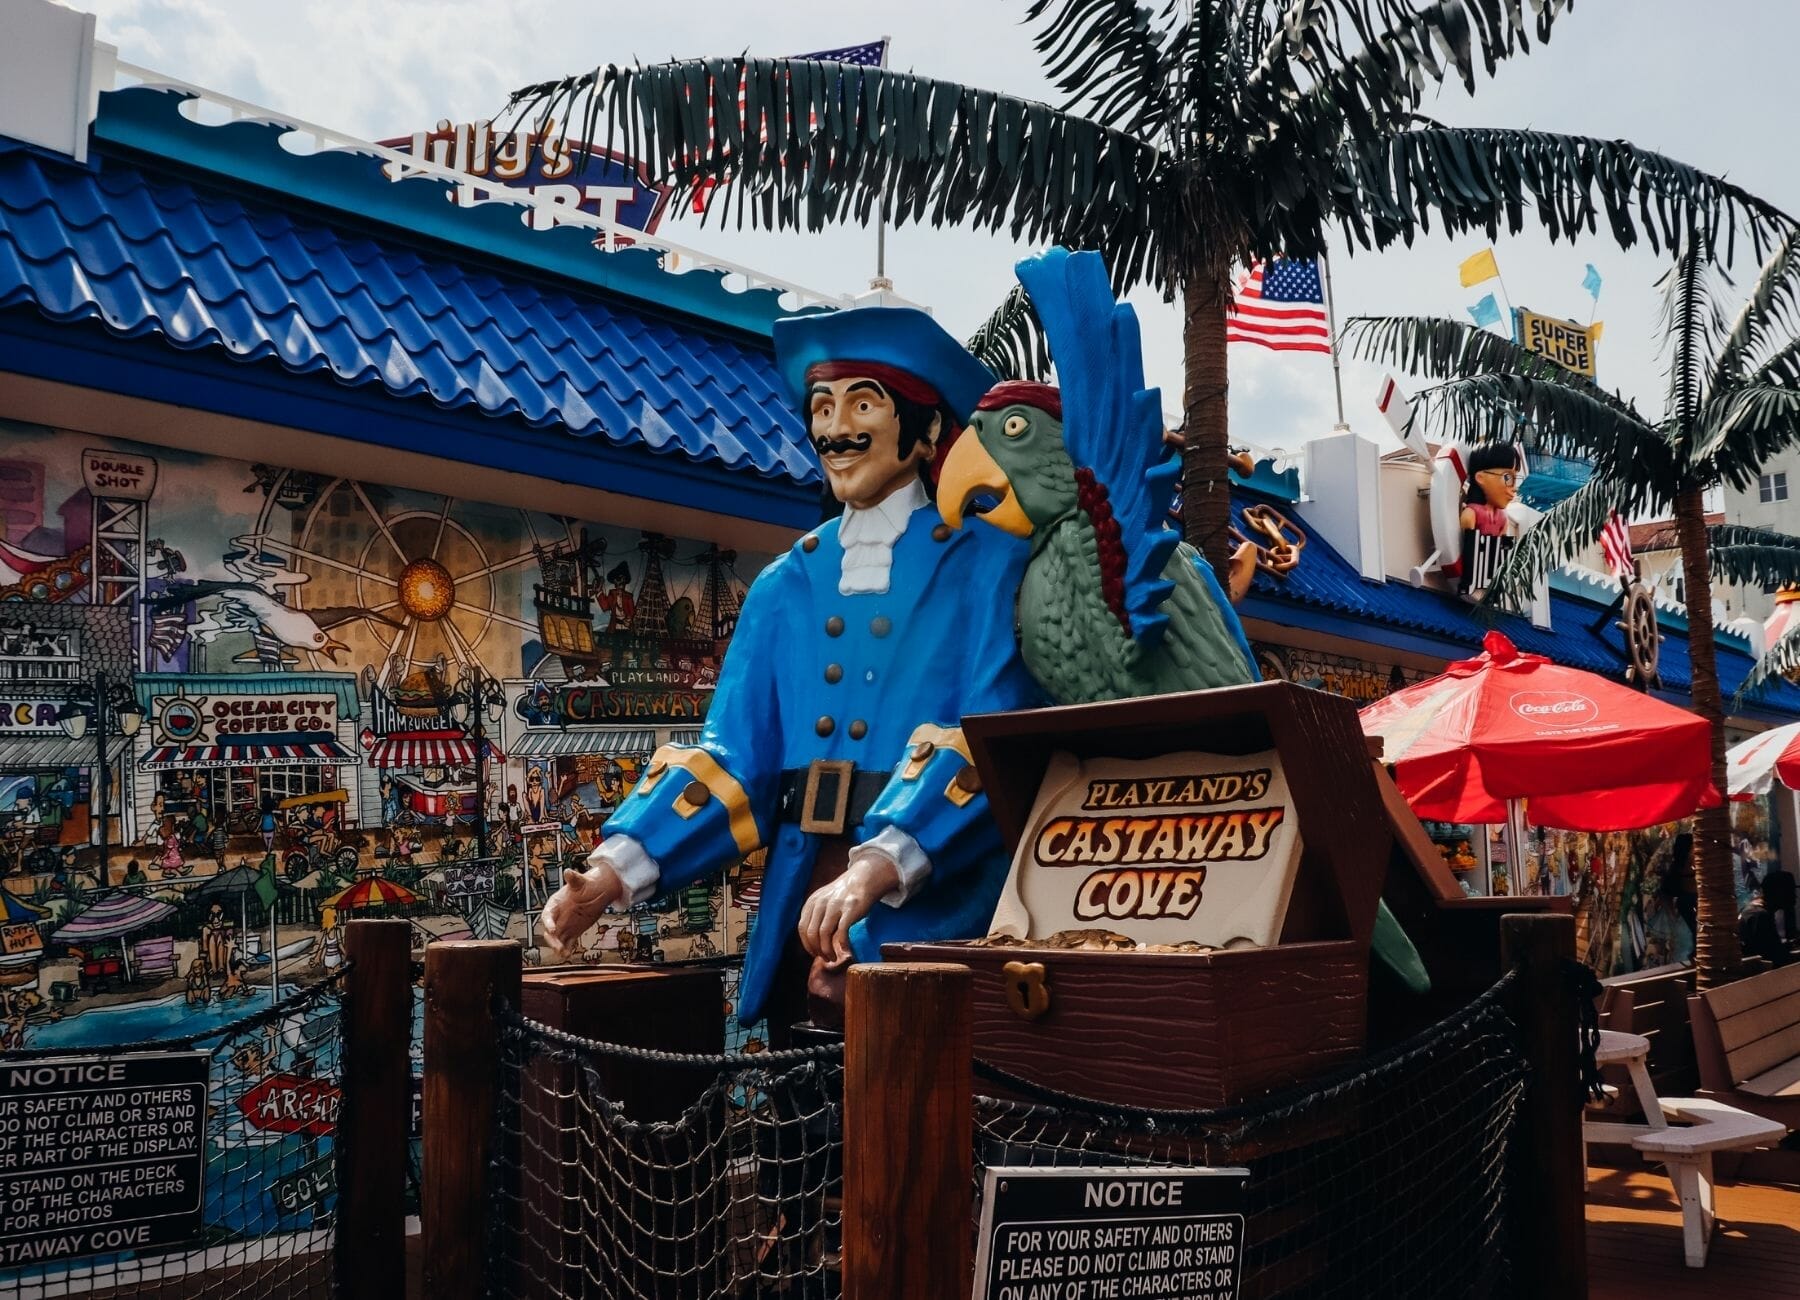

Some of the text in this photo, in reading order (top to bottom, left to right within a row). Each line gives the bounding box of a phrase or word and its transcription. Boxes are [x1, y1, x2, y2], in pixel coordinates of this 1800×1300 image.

[382, 118, 573, 181] Jilly's
[1530, 318, 1588, 352] SUPER
[1532, 337, 1589, 370] SLIDE
[90, 459, 144, 476] DOUBLE
[95, 474, 140, 489] SHOT
[612, 671, 690, 684] PLAYLAND'S
[212, 701, 336, 717] OCEAN CITY
[567, 689, 704, 718] CASTAWAY
[1518, 699, 1587, 715] Coca-Cola
[215, 715, 331, 733] COFFEE CO.
[140, 762, 177, 771] COFFEE
[183, 759, 232, 767] ESPRESSO
[1085, 772, 1268, 807] PLAYLAND'S
[1037, 808, 1284, 862] CASTAWAY
[1077, 871, 1202, 918] COVE
[10, 934, 34, 950] HUT
[10, 1064, 126, 1087] NOTICE
[24, 1096, 89, 1114] SAFETY
[92, 1093, 126, 1109] AND
[131, 1088, 192, 1106] OTHERS
[26, 1115, 60, 1131] NOT
[65, 1110, 115, 1128] CLIMB
[121, 1109, 143, 1123] OR
[146, 1104, 196, 1120] STAND
[23, 1132, 56, 1148] THE
[60, 1122, 168, 1145] CHARACTERS
[172, 1120, 194, 1135] OR
[23, 1148, 66, 1166] PART
[71, 1146, 93, 1161] OF
[99, 1142, 128, 1158] THE
[132, 1135, 198, 1156] DISPLAY.
[9, 1176, 66, 1196] STAND
[70, 1173, 95, 1188] ON
[100, 1169, 130, 1186] THE
[135, 1163, 177, 1181] DECK
[12, 1197, 35, 1212] OF
[41, 1193, 73, 1209] THE
[78, 1179, 185, 1204] CHARACTERS
[1084, 1181, 1184, 1208] NOTICE
[4, 1204, 113, 1231] FOR PHOTOS
[0, 1225, 151, 1263] TAWAY COVE
[1007, 1222, 1233, 1252] FOR YOUR SAFETY AND OTHERS
[999, 1245, 1235, 1280] PLEASE DO NOT CLIMB OR STAND
[999, 1286, 1023, 1300] ON
[1028, 1282, 1064, 1300] ANY
[1066, 1280, 1086, 1300] OF
[1091, 1277, 1119, 1300] THE
[1122, 1270, 1212, 1296] CHARACTERS
[1214, 1268, 1232, 1288] OR
